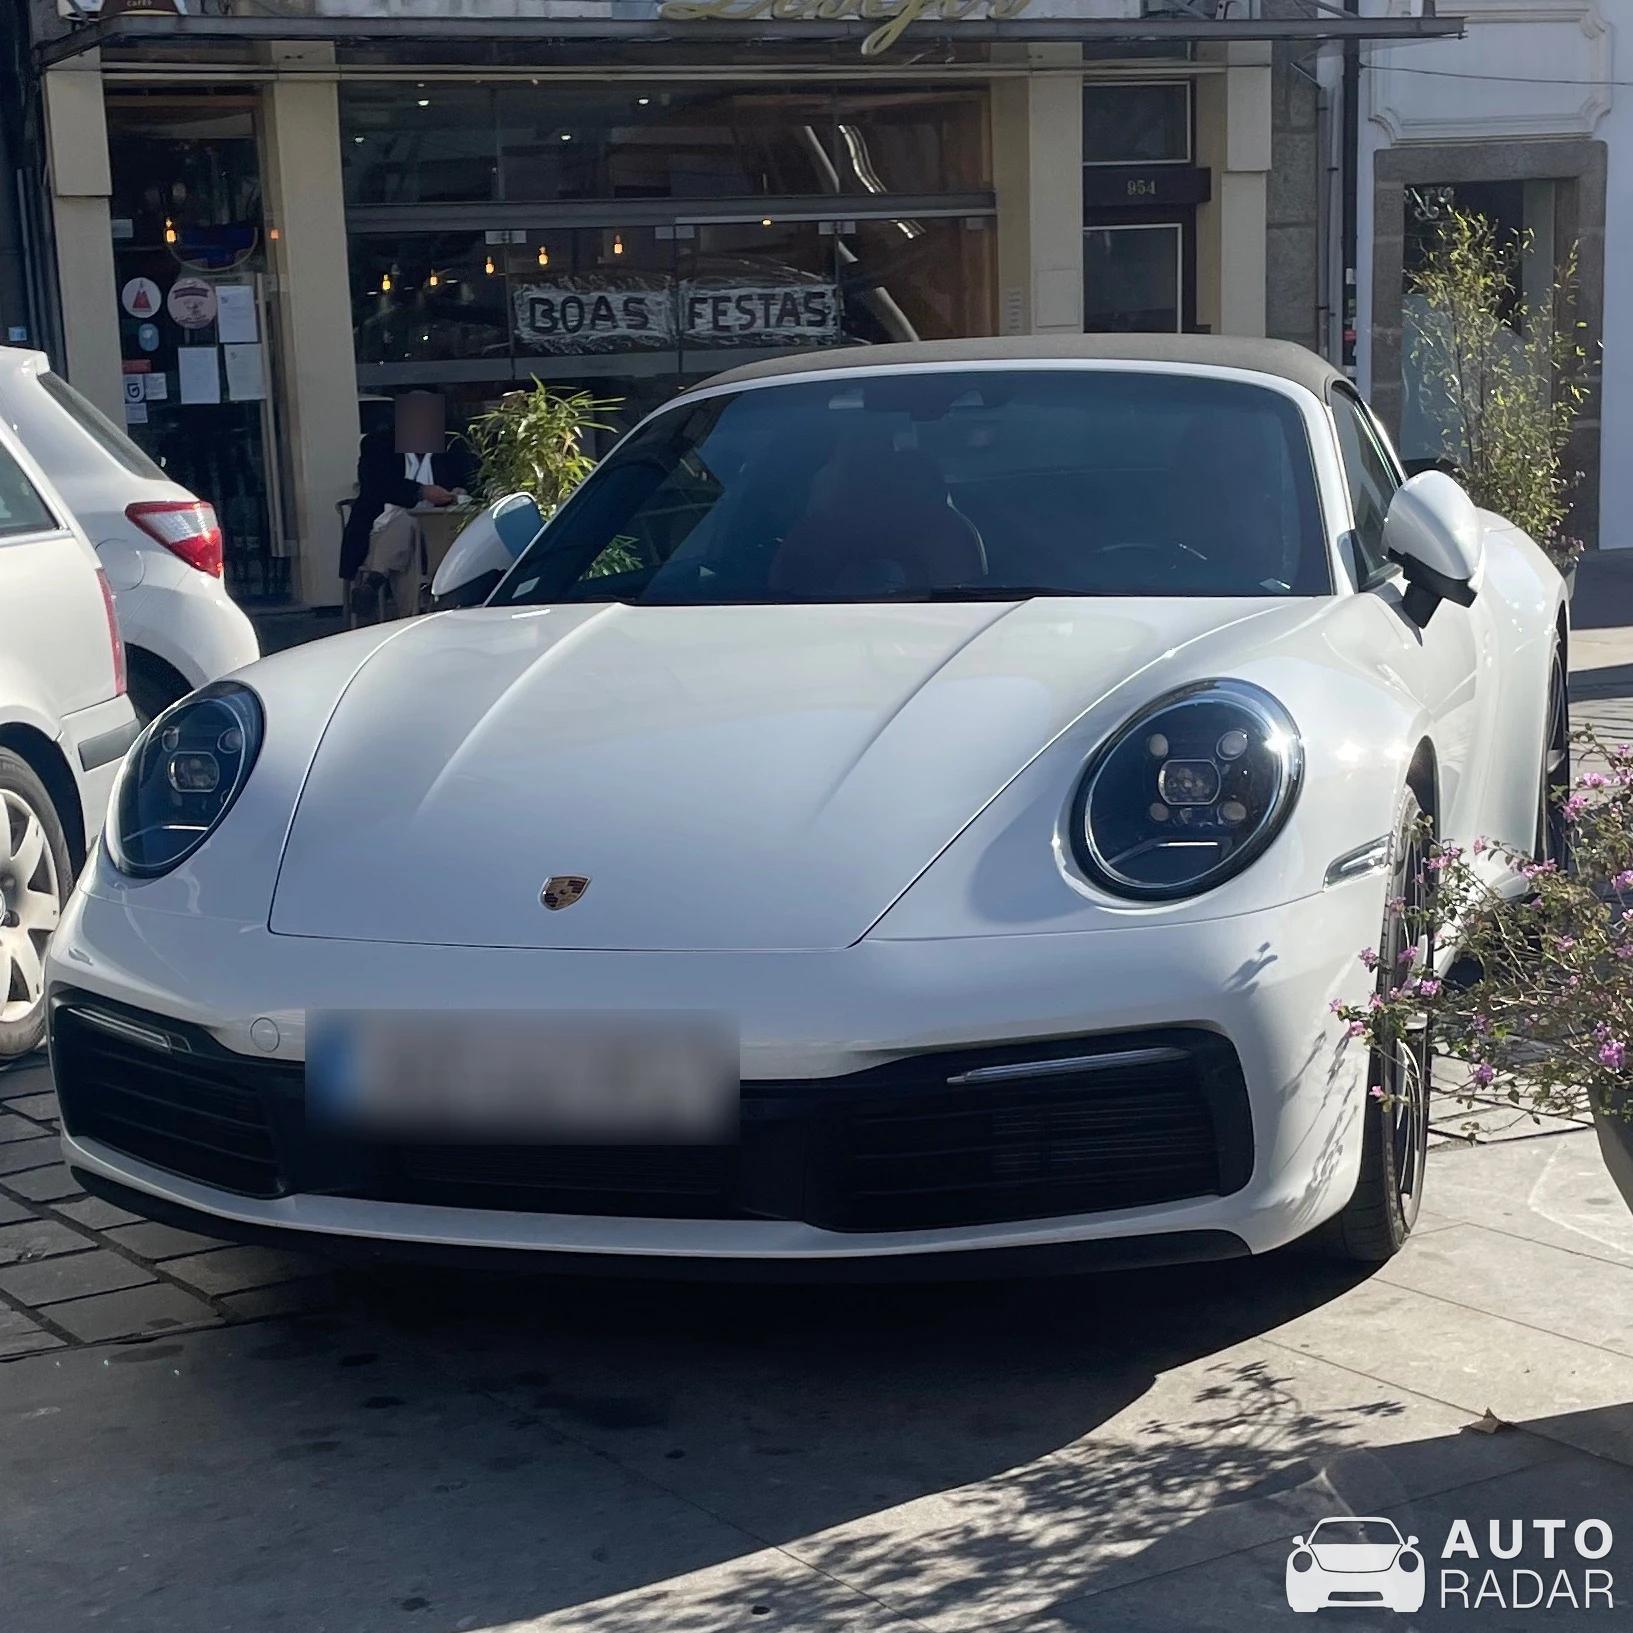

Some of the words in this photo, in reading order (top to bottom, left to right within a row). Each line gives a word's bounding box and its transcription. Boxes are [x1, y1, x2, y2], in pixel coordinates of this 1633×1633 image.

[1126, 180, 1156, 195] 954
[529, 295, 650, 333] BOAS
[688, 291, 828, 331] FESTAS
